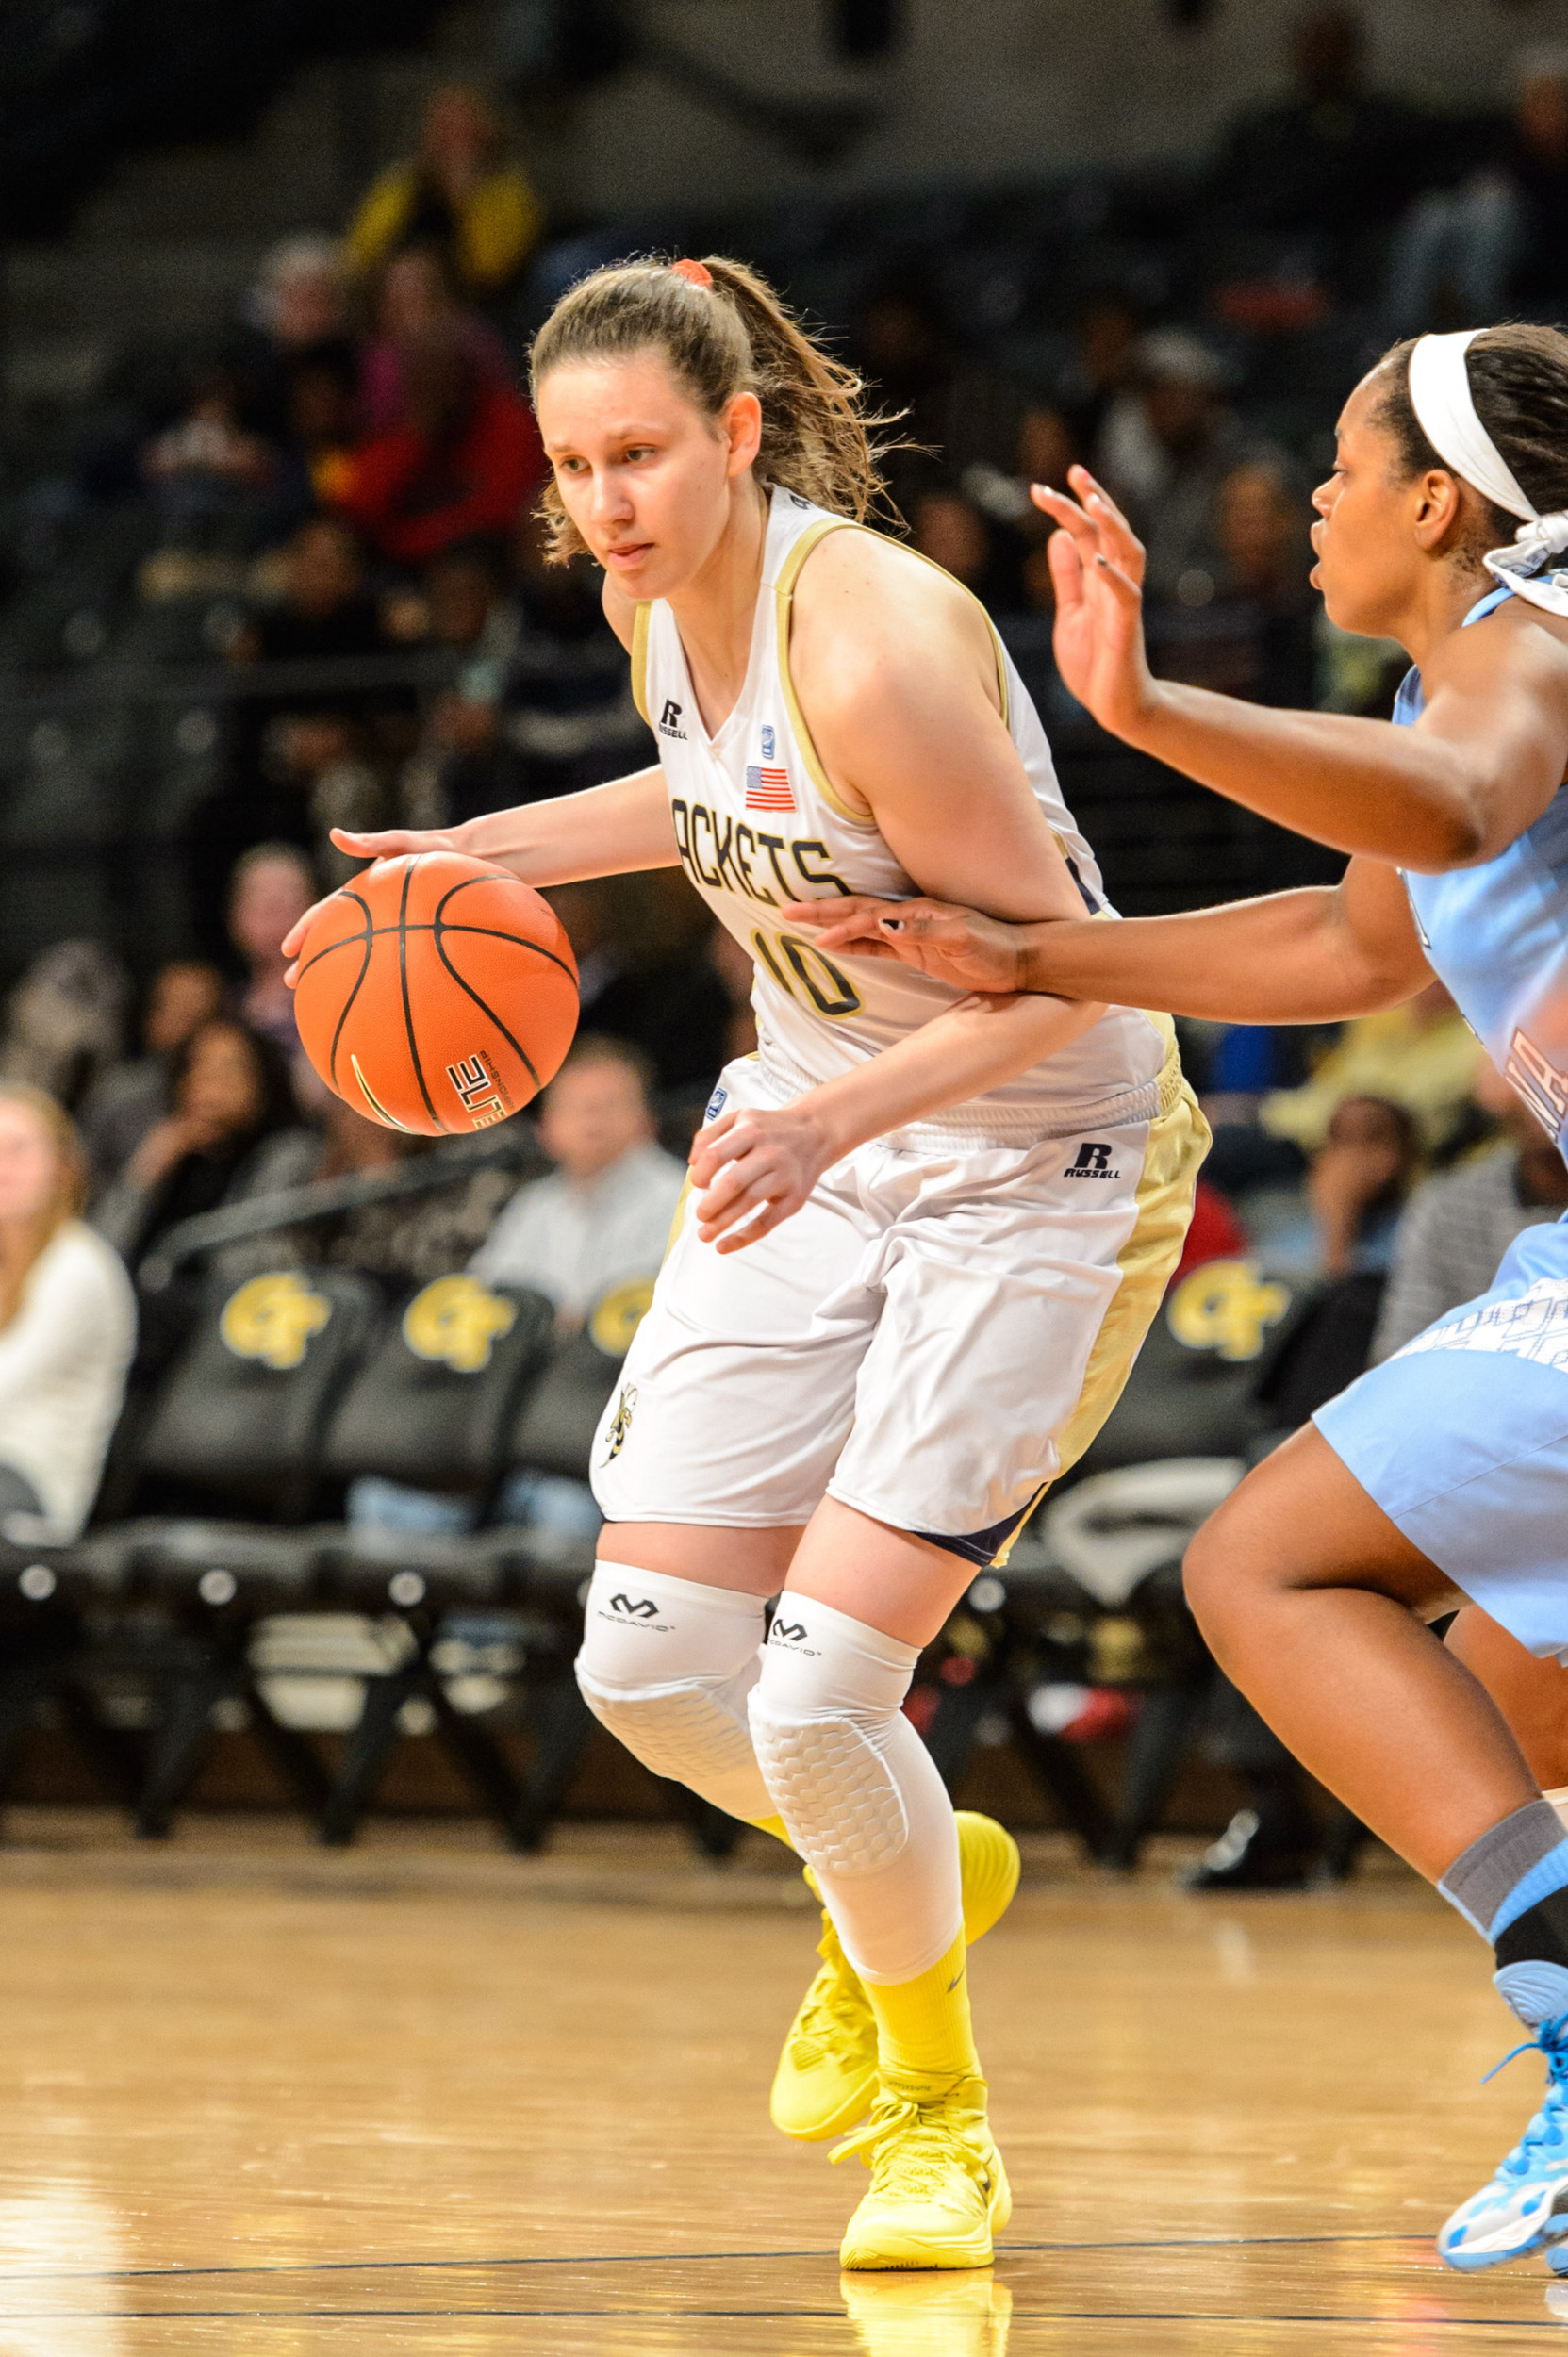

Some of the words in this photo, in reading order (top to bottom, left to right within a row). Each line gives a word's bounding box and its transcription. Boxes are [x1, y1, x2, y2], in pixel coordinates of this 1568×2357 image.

[659, 725, 688, 741] SSELL
[672, 799, 855, 907] ACKETS
[751, 928, 866, 1020] 10
[1074, 1143, 1112, 1170] R
[1064, 1168, 1121, 1179] RUSSELL
